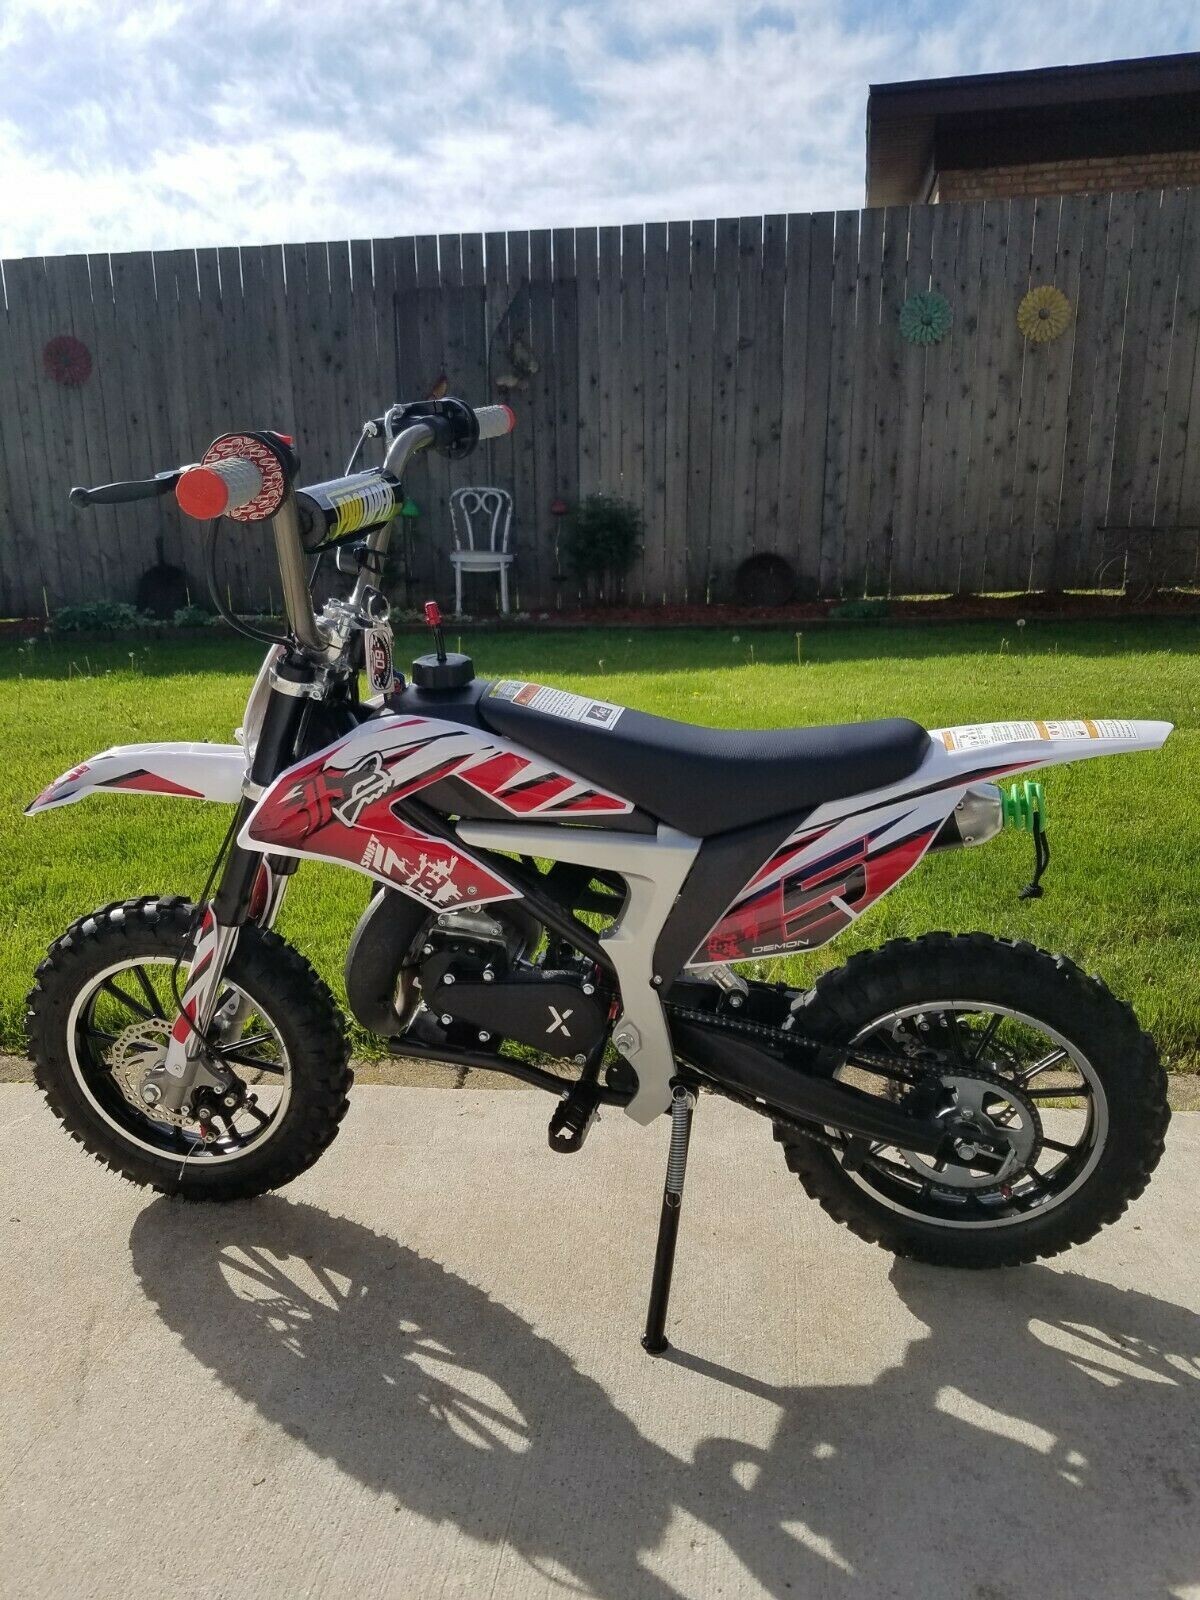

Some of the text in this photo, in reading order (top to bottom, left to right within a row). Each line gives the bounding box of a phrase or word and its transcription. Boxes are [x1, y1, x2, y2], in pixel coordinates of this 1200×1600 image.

[360, 833, 380, 868] SHIFT
[751, 938, 810, 954] DEMON
[545, 1005, 574, 1037] X
